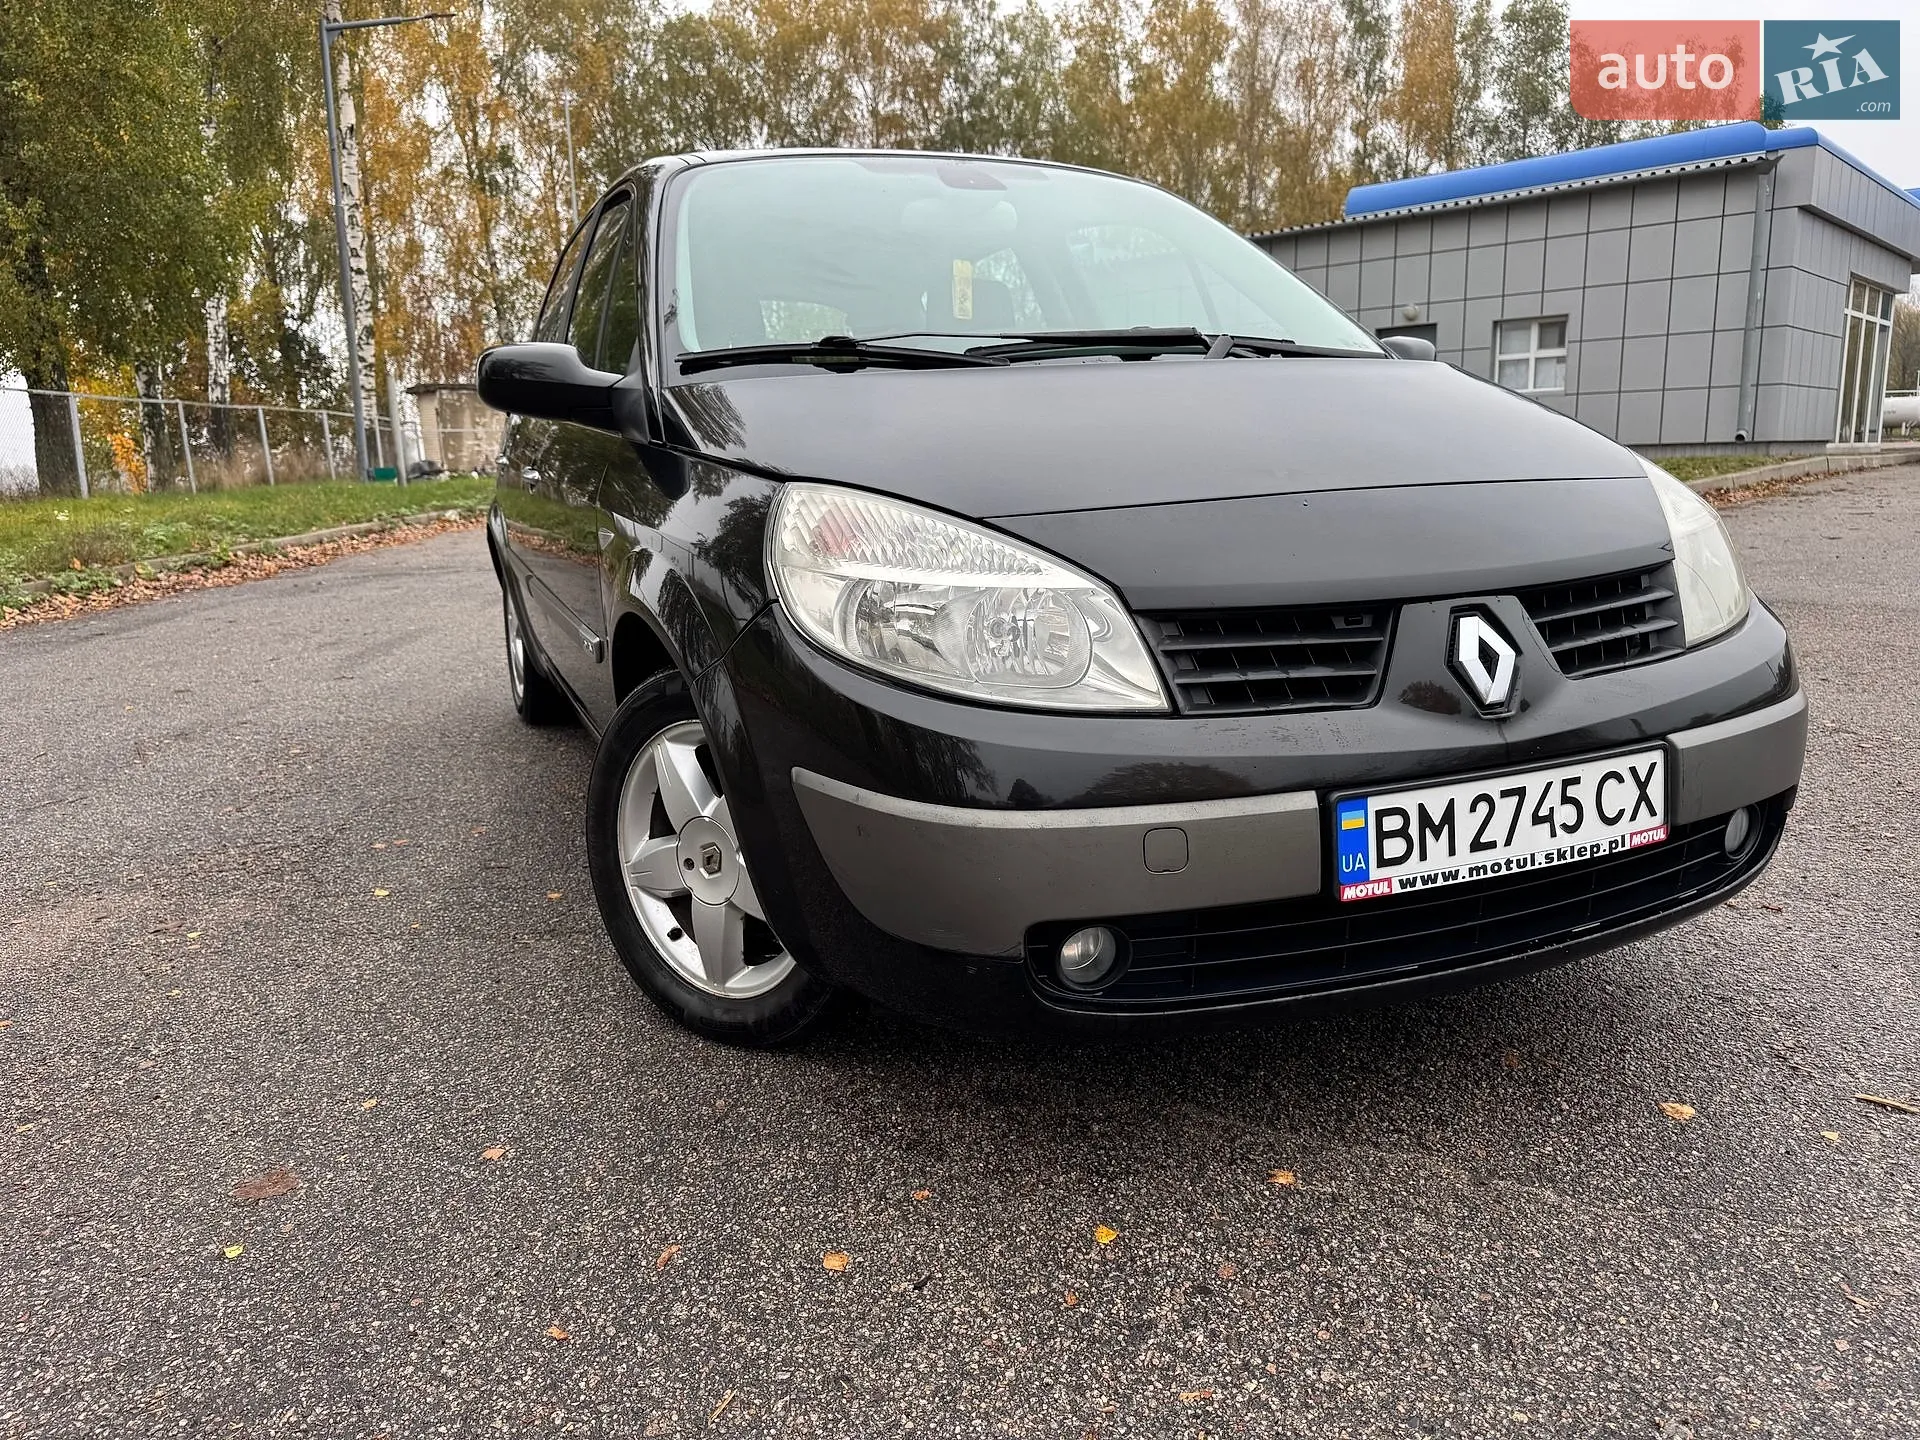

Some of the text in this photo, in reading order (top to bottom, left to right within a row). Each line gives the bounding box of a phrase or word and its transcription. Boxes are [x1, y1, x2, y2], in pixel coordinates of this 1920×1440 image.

[1374, 761, 1658, 869] BM 2745 CX
[1631, 828, 1666, 847] MOTUL
[1342, 852, 1367, 873] UA
[1398, 834, 1626, 890] www.motul.sklep.pl
[1343, 881, 1391, 900] MOTUL
